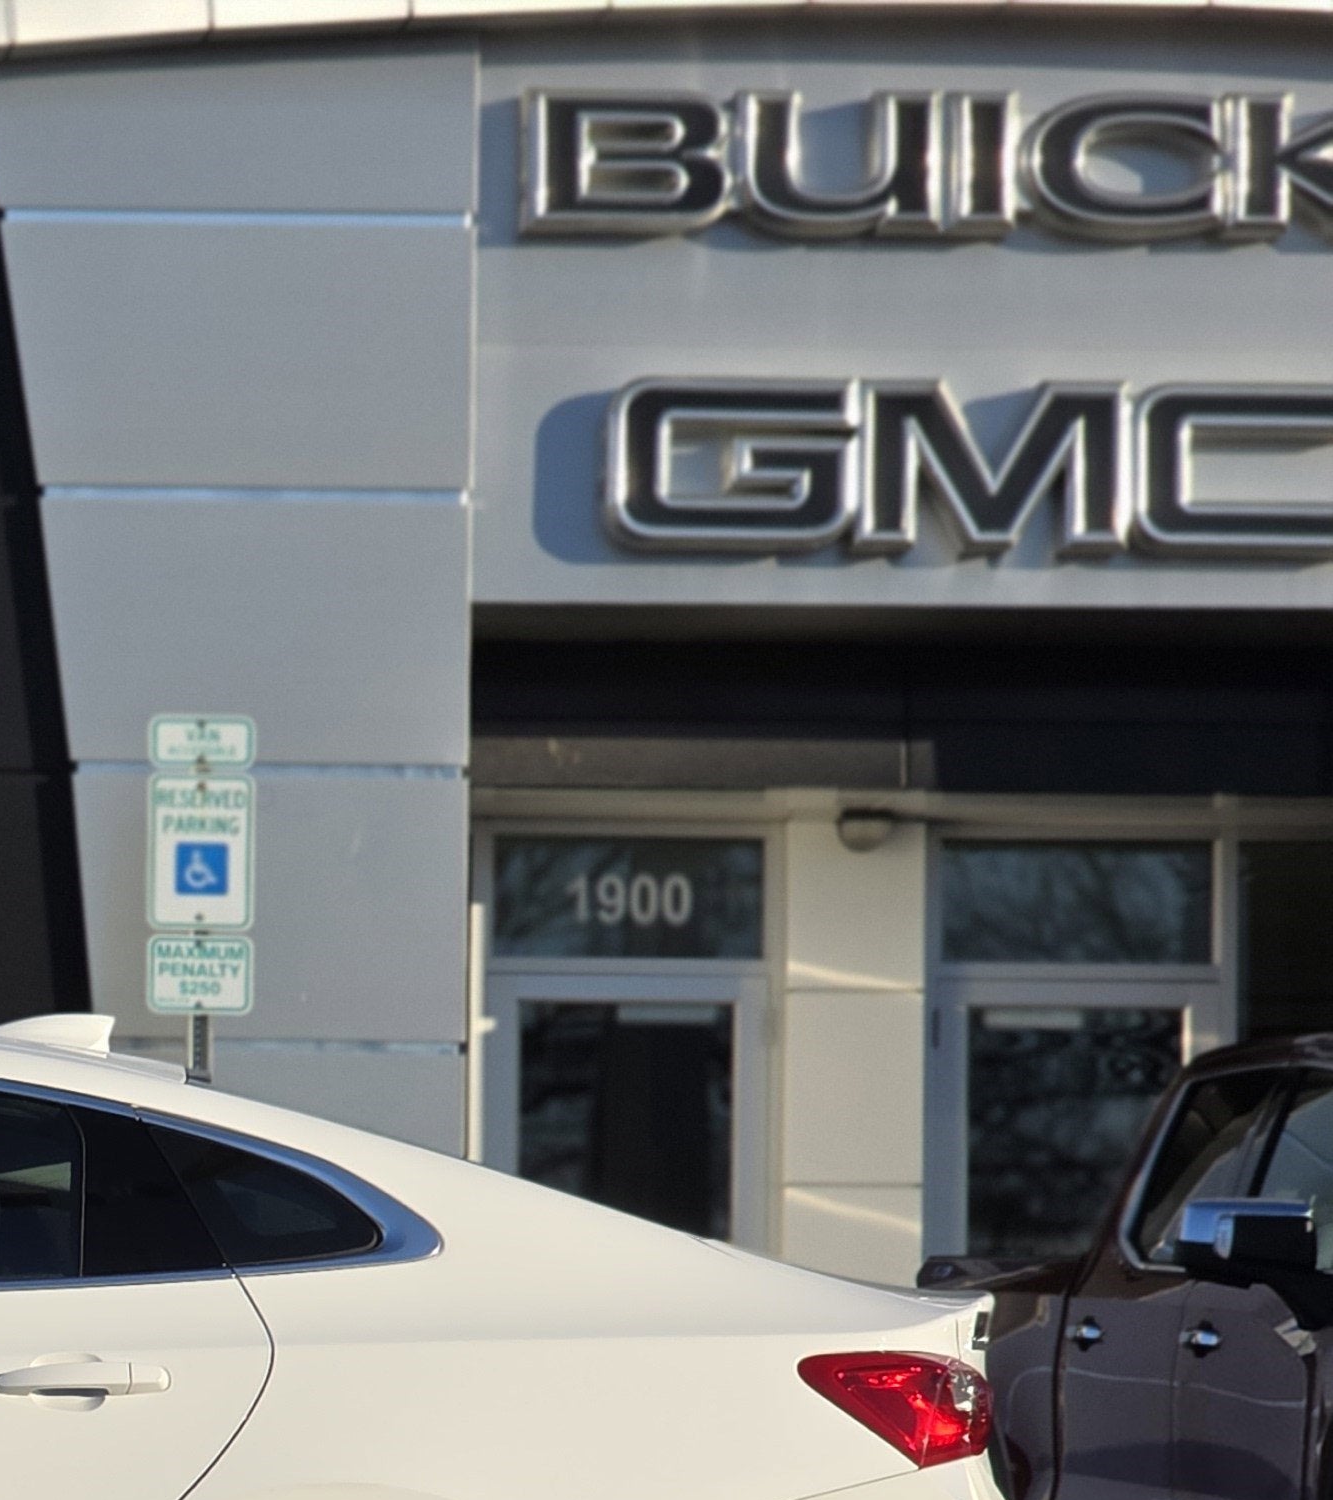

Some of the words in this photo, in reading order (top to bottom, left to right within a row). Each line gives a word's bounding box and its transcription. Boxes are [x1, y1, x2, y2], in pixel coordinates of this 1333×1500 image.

[605, 376, 1333, 558] GMC
[162, 815, 240, 835] PARKING
[566, 873, 693, 926] 1900
[156, 944, 245, 959] MAXIMUM
[158, 962, 240, 978] PENALTY
[179, 981, 221, 996] $250
